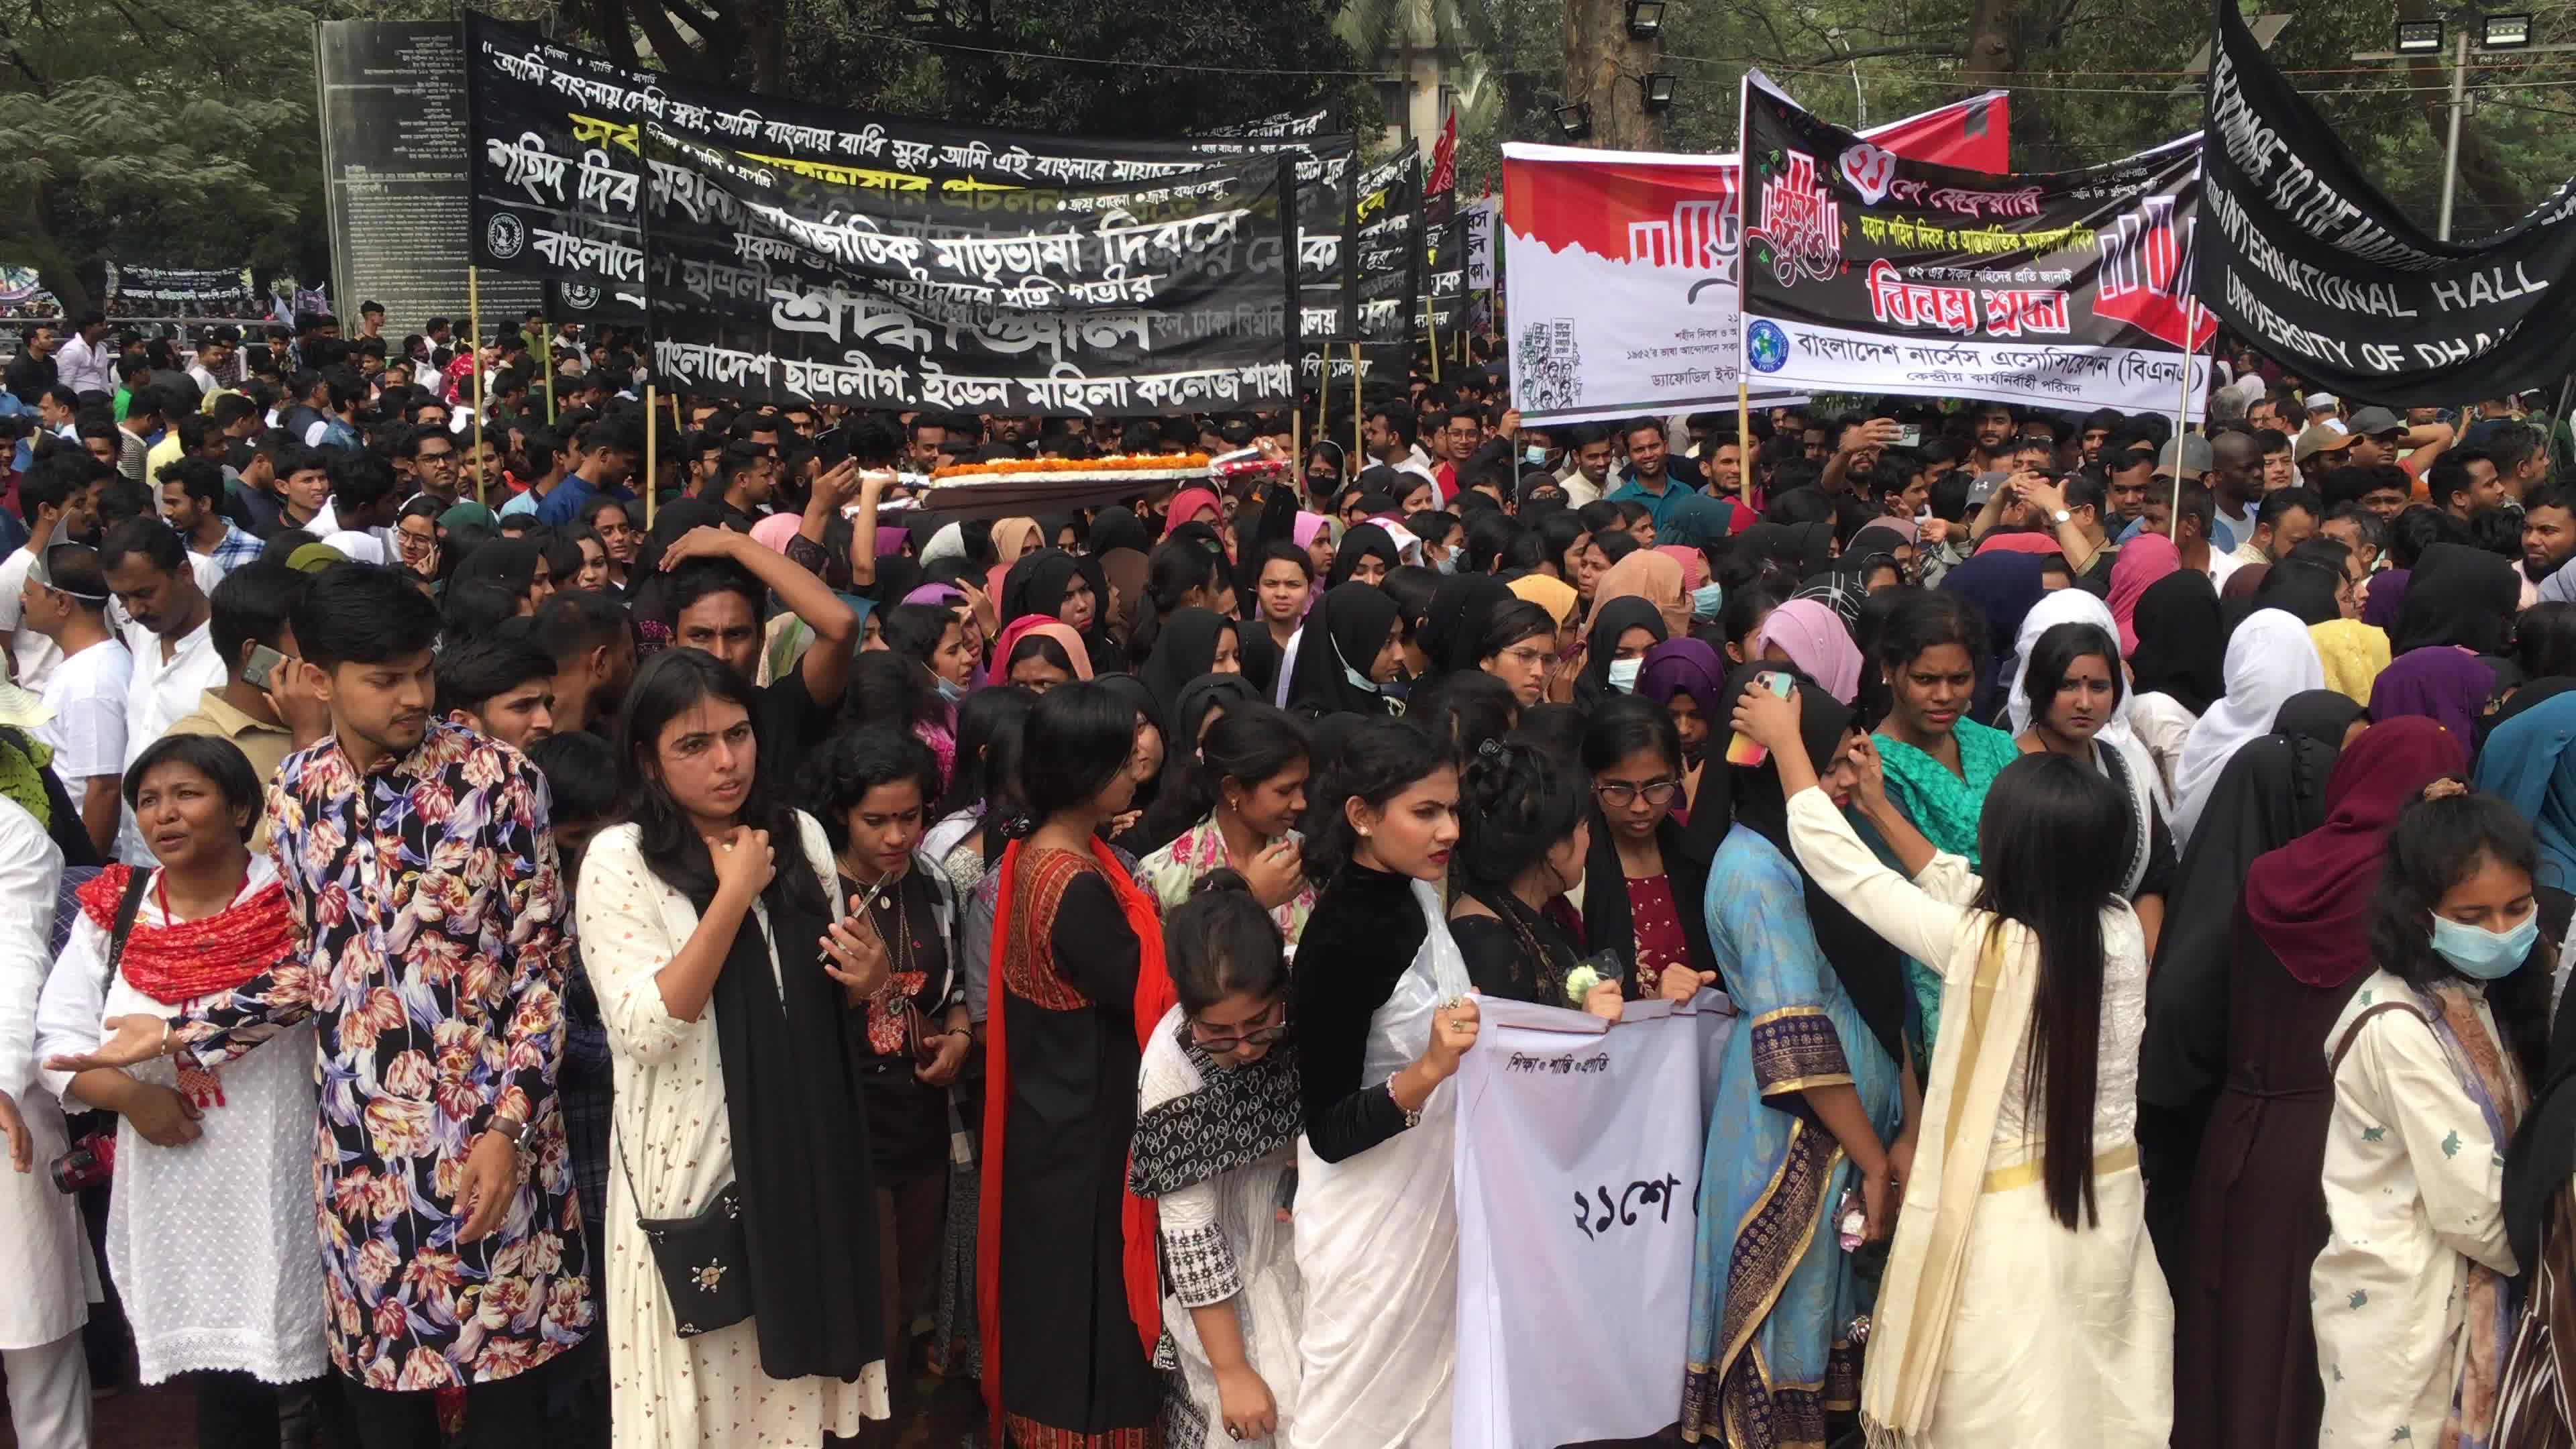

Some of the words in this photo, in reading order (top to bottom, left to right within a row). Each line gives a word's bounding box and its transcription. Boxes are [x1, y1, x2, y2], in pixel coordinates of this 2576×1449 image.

[550, 70, 625, 108] বাংলায়
[765, 120, 836, 155] বাংলায়
[940, 141, 992, 170] আমি
[993, 145, 1035, 180] এই
[1035, 156, 1110, 184] বাংলার
[577, 148, 640, 213] দিব
[533, 228, 645, 282] বাংলাদে
[928, 229, 1085, 286] মাতৃভাষা
[1092, 208, 1251, 266] দিবসে
[2220, 189, 2418, 318] INTERNATIONAL
[2430, 260, 2549, 313] HALL
[1794, 332, 1900, 365] বাংলাদেশ
[1904, 343, 1982, 367] নার্সেস
[2226, 264, 2354, 369] UNIVERSITY
[2361, 343, 2406, 372] OF
[2413, 317, 2524, 369] DHA
[919, 355, 1014, 411] ইডেন
[1015, 362, 1132, 417] মহিলা
[1131, 368, 1240, 408] কলেজ
[1238, 360, 1293, 398] শাখা
[1715, 366, 1739, 384] ইন্টা
[2041, 378, 2083, 396] পরিষদ
[1573, 1171, 1682, 1242] ২১শে
